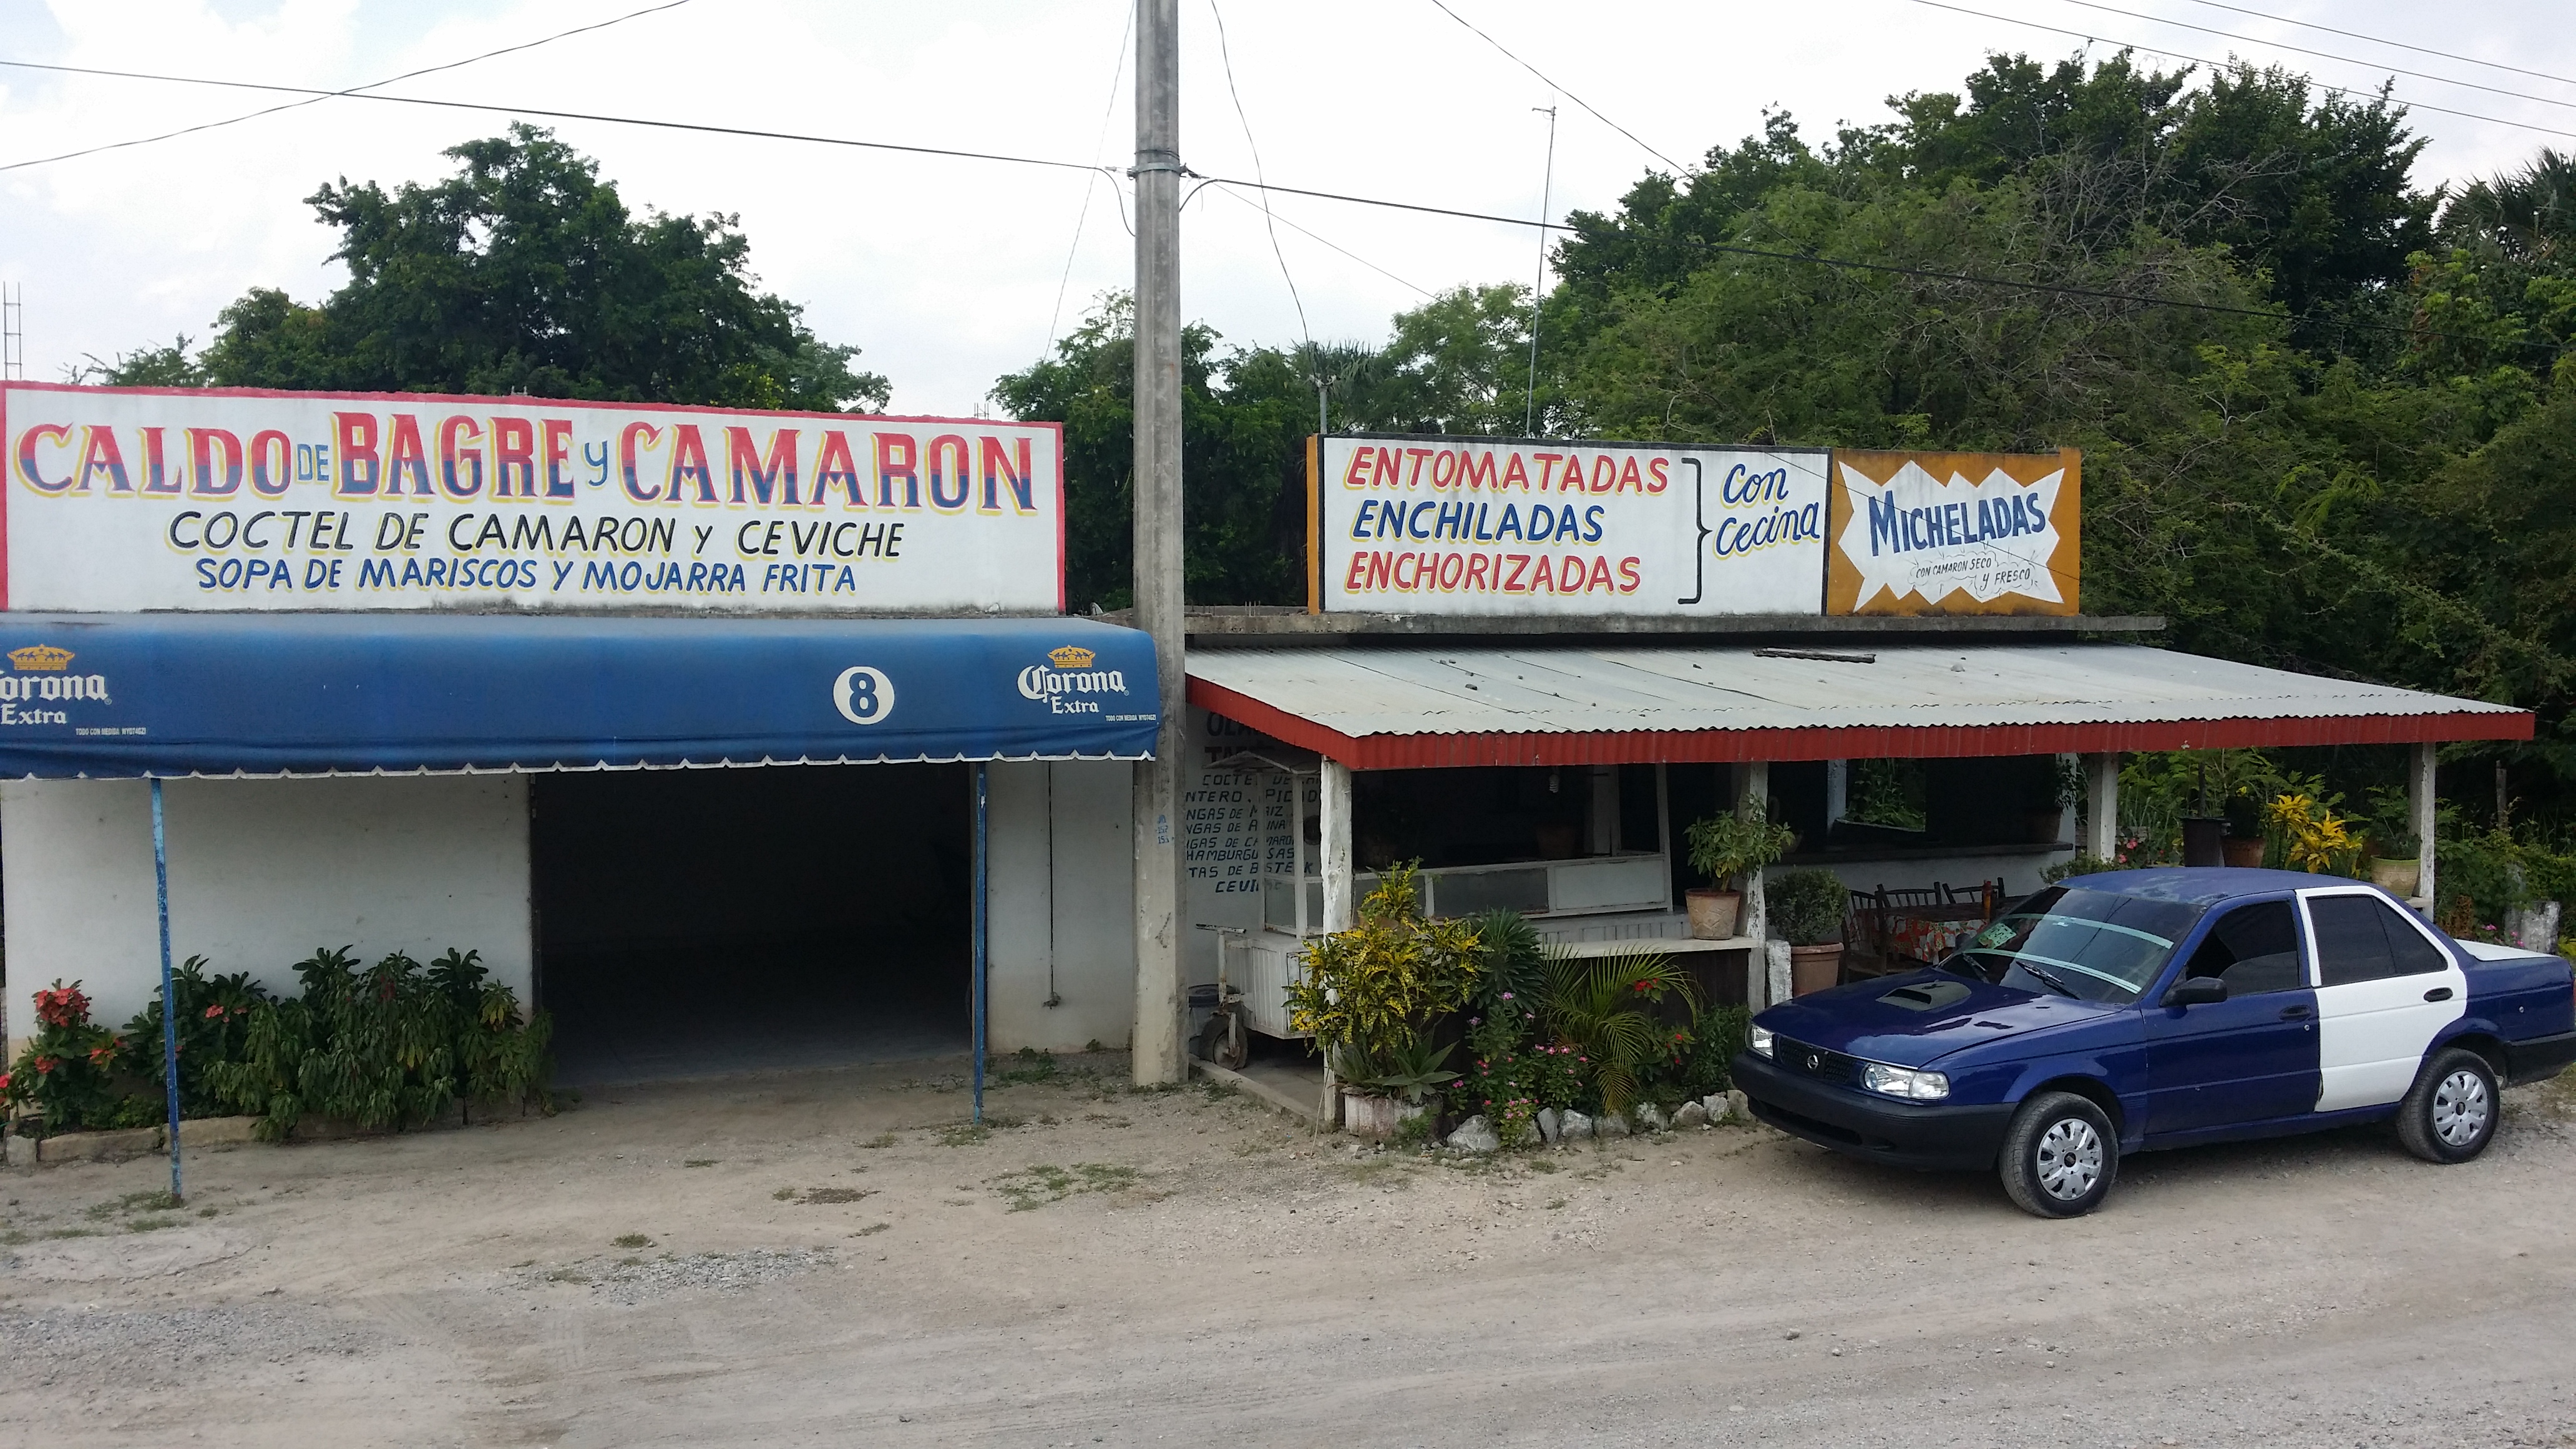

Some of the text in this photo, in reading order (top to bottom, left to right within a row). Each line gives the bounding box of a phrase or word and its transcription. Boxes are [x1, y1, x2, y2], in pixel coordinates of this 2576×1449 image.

[15, 422, 291, 499] CALDO
[297, 444, 329, 481] DE
[331, 412, 575, 503] BAGRE
[620, 421, 1037, 514] CAMARON
[1345, 446, 1669, 495] ENTOMATADAS
[1722, 464, 1789, 507] Con
[167, 510, 354, 553] COCTEL
[374, 512, 429, 551] DE
[448, 513, 676, 553] CAMARON
[737, 520, 905, 557] CEVICHE
[1351, 499, 1605, 544] ENCHILADAS
[1868, 490, 2046, 557] MICHELADAS
[195, 557, 856, 593] SOPA DE MARISCOS Y MOJARRA FRITA
[1345, 551, 1641, 593] ENCHORIZADAS
[1915, 558, 1992, 578] CON CAMARON SECO
[1994, 568, 2031, 585] FRESCO
[0, 670, 109, 701] orona
[849, 671, 880, 718] 8
[1017, 664, 1126, 703] Corona
[0, 703, 67, 725] Extra
[1050, 696, 1100, 714] Extra
[1202, 774, 1257, 786] COCTE
[1227, 822, 1241, 832] DE
[1229, 808, 1243, 819] DE
[1225, 837, 1239, 847] DE
[1227, 865, 1243, 876] DE
